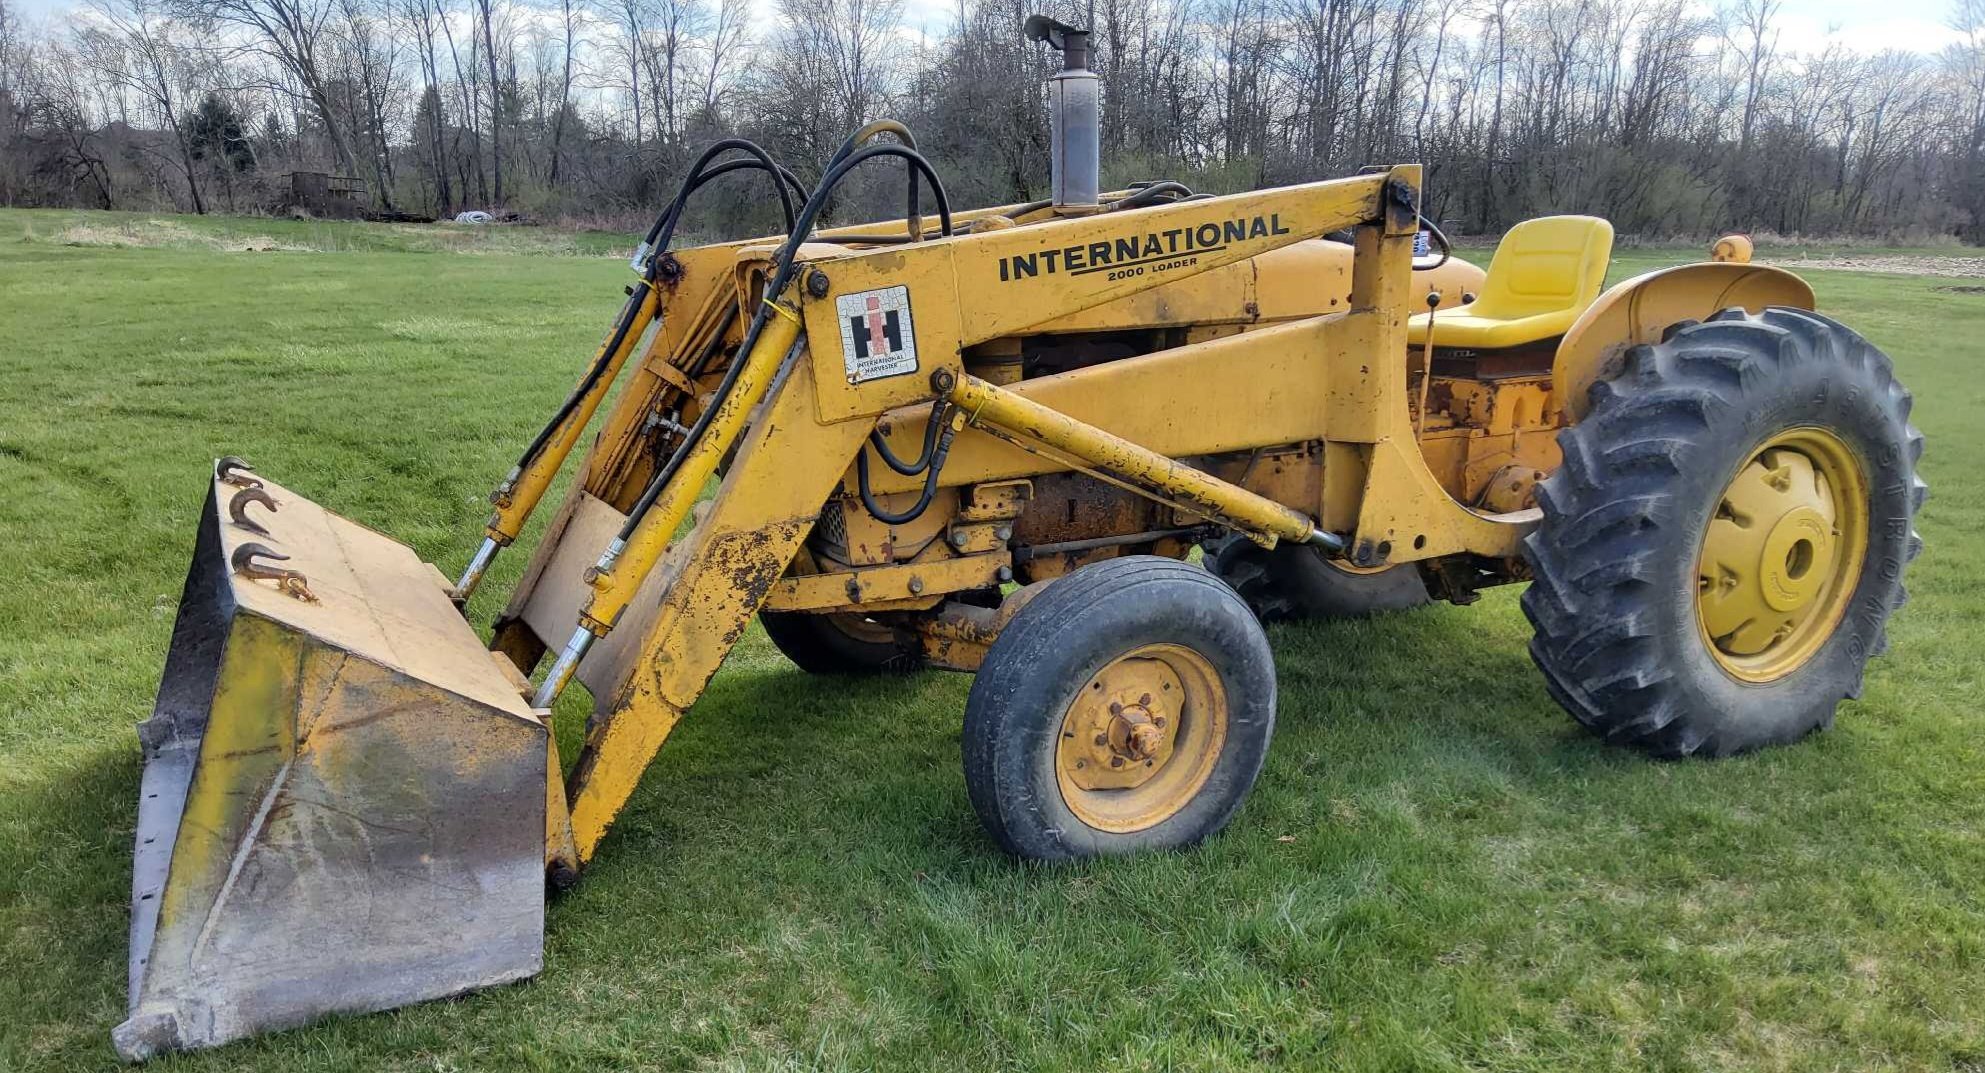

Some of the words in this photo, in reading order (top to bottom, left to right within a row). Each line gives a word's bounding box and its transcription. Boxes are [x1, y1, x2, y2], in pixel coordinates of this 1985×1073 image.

[998, 213, 1290, 282] INTERNATIONAL
[1107, 267, 1145, 282] 2000
[1151, 257, 1198, 273] LOADER
[856, 355, 904, 369] INTERNATIONAL
[865, 362, 898, 374] HARVESTER
